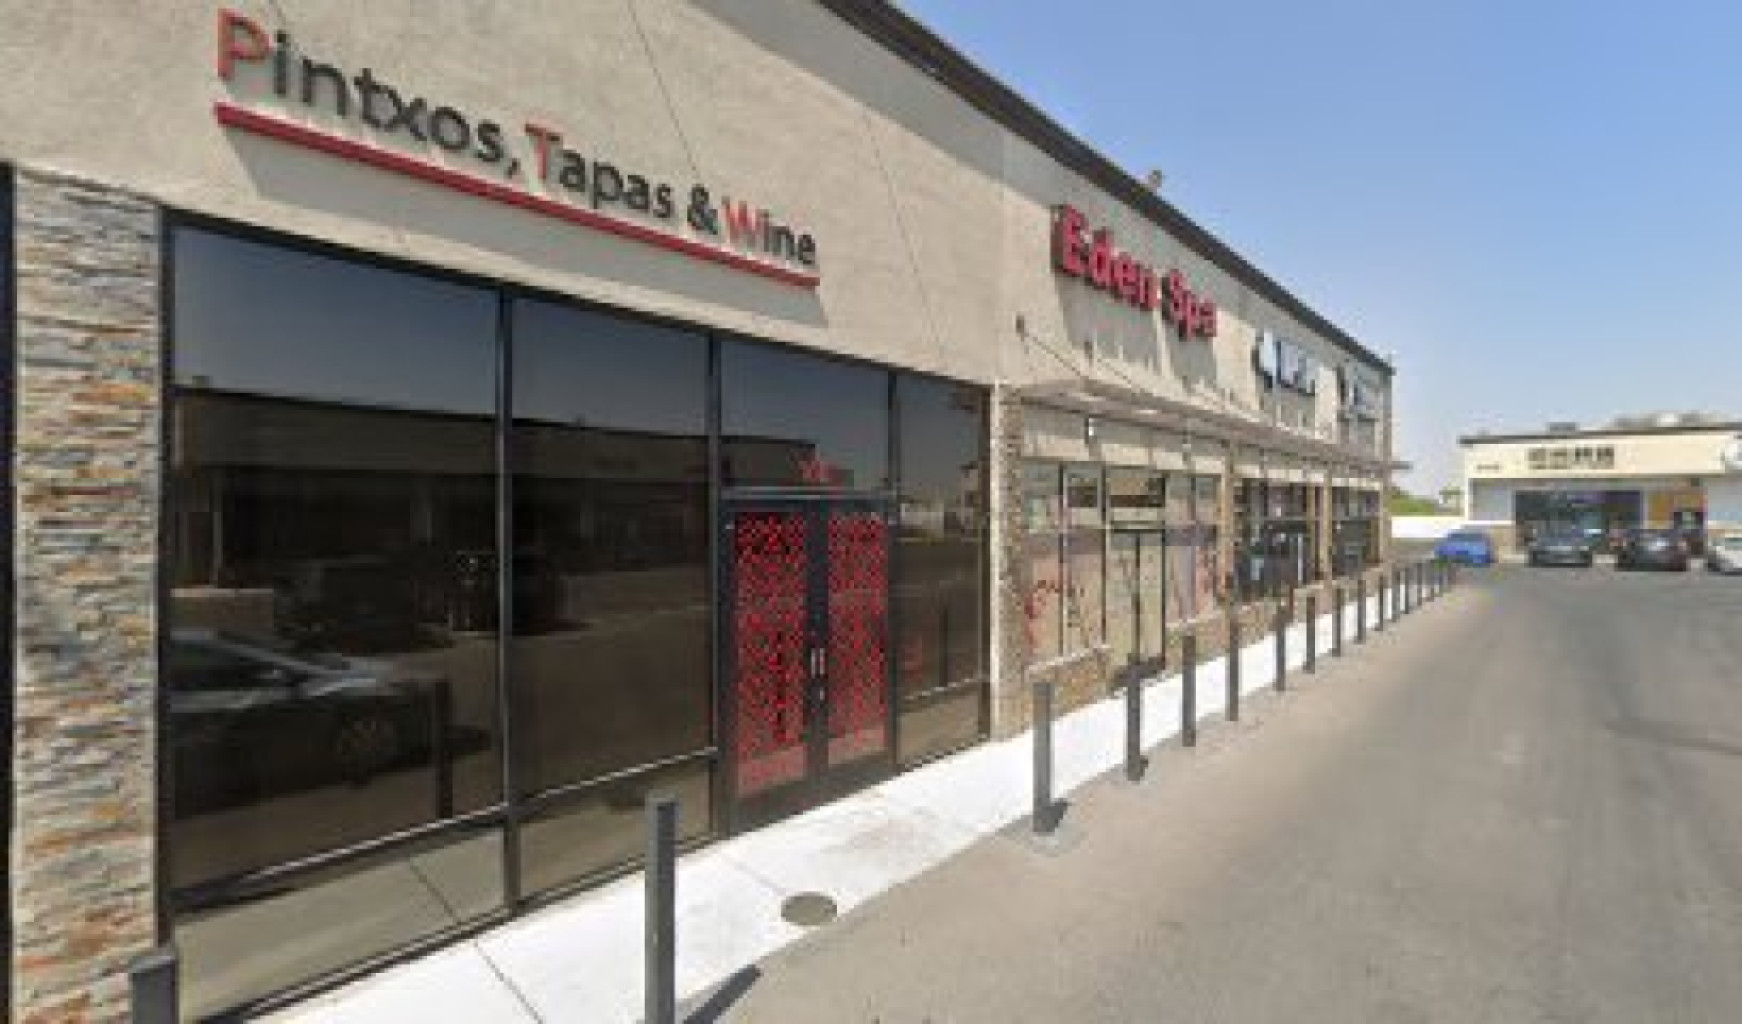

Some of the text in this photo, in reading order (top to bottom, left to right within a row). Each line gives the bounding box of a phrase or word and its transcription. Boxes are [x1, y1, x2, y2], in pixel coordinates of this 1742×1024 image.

[217, 9, 817, 265] Pintxos, Tapas & Wine
[1054, 205, 1217, 341] Eden Spa
